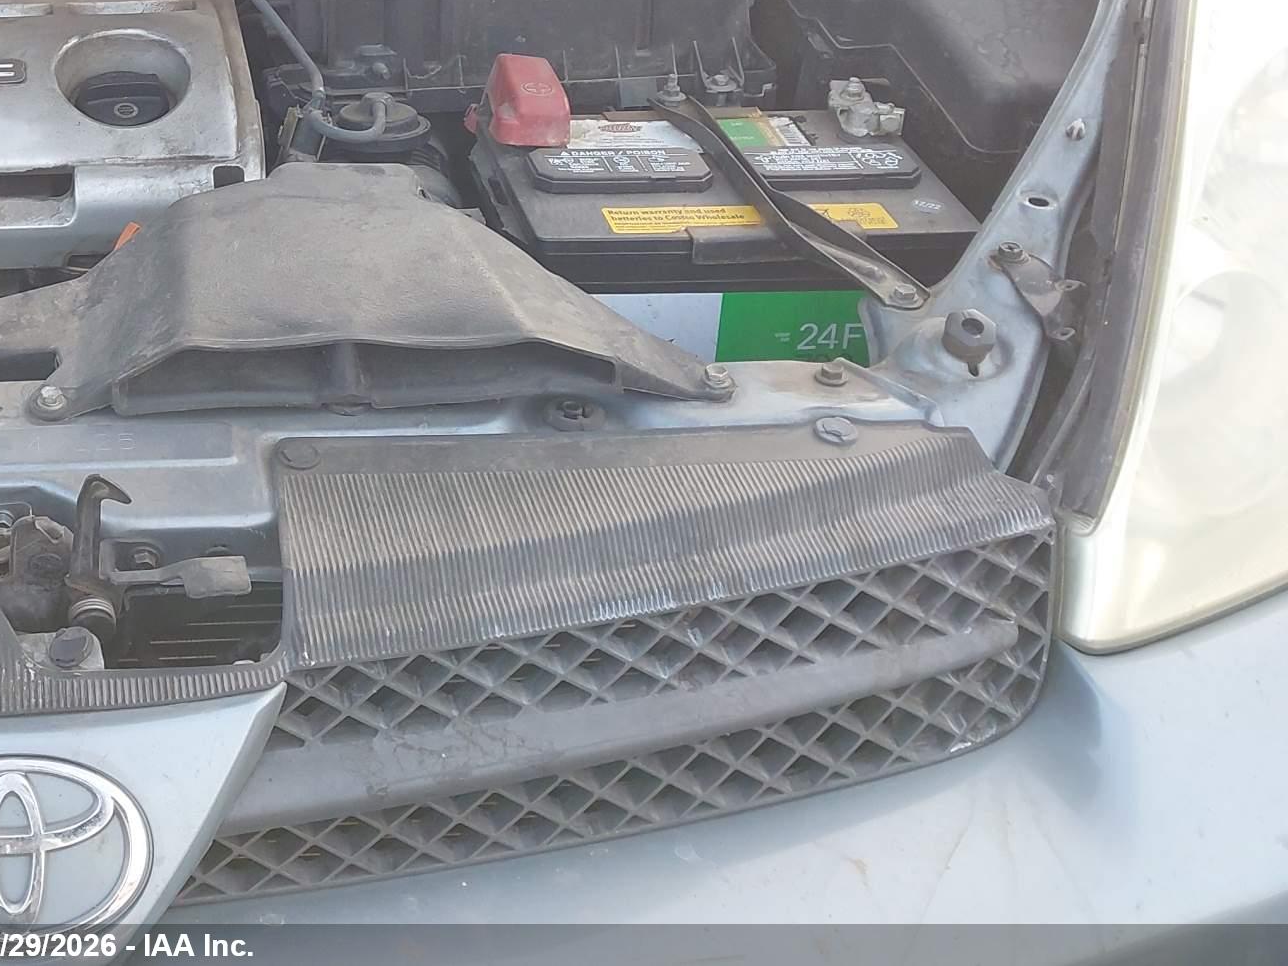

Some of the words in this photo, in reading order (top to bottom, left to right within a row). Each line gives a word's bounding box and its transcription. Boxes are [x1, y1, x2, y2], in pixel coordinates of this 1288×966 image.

[641, 209, 683, 217] warranty
[704, 207, 726, 215] used
[610, 214, 653, 222] batteries
[697, 213, 745, 221] Wholesale
[797, 323, 865, 350] 24F
